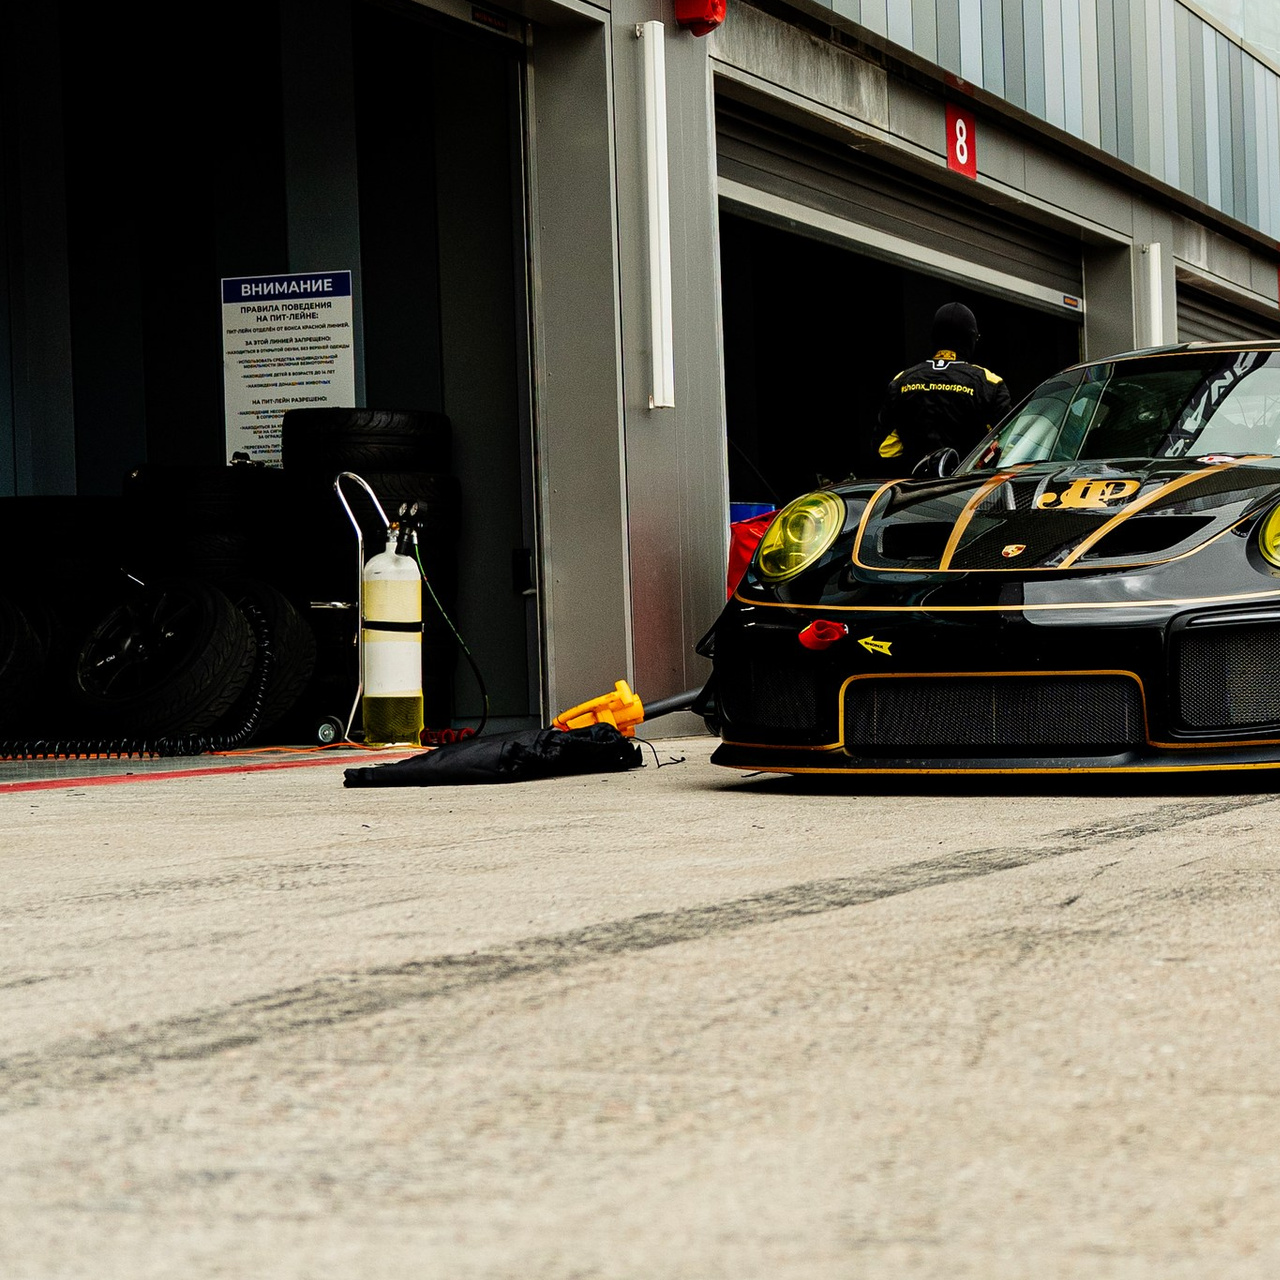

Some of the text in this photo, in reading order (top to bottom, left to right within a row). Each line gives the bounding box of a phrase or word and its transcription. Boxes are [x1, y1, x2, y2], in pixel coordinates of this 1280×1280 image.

[955, 118, 968, 165] 8
[241, 279, 333, 296] ВНИМАНИЕ
[240, 301, 332, 314] ПРАВИЛА ПОВЕДЕНИЯ
[270, 311, 319, 322] ПИТ-ЛЕЙНЕ:
